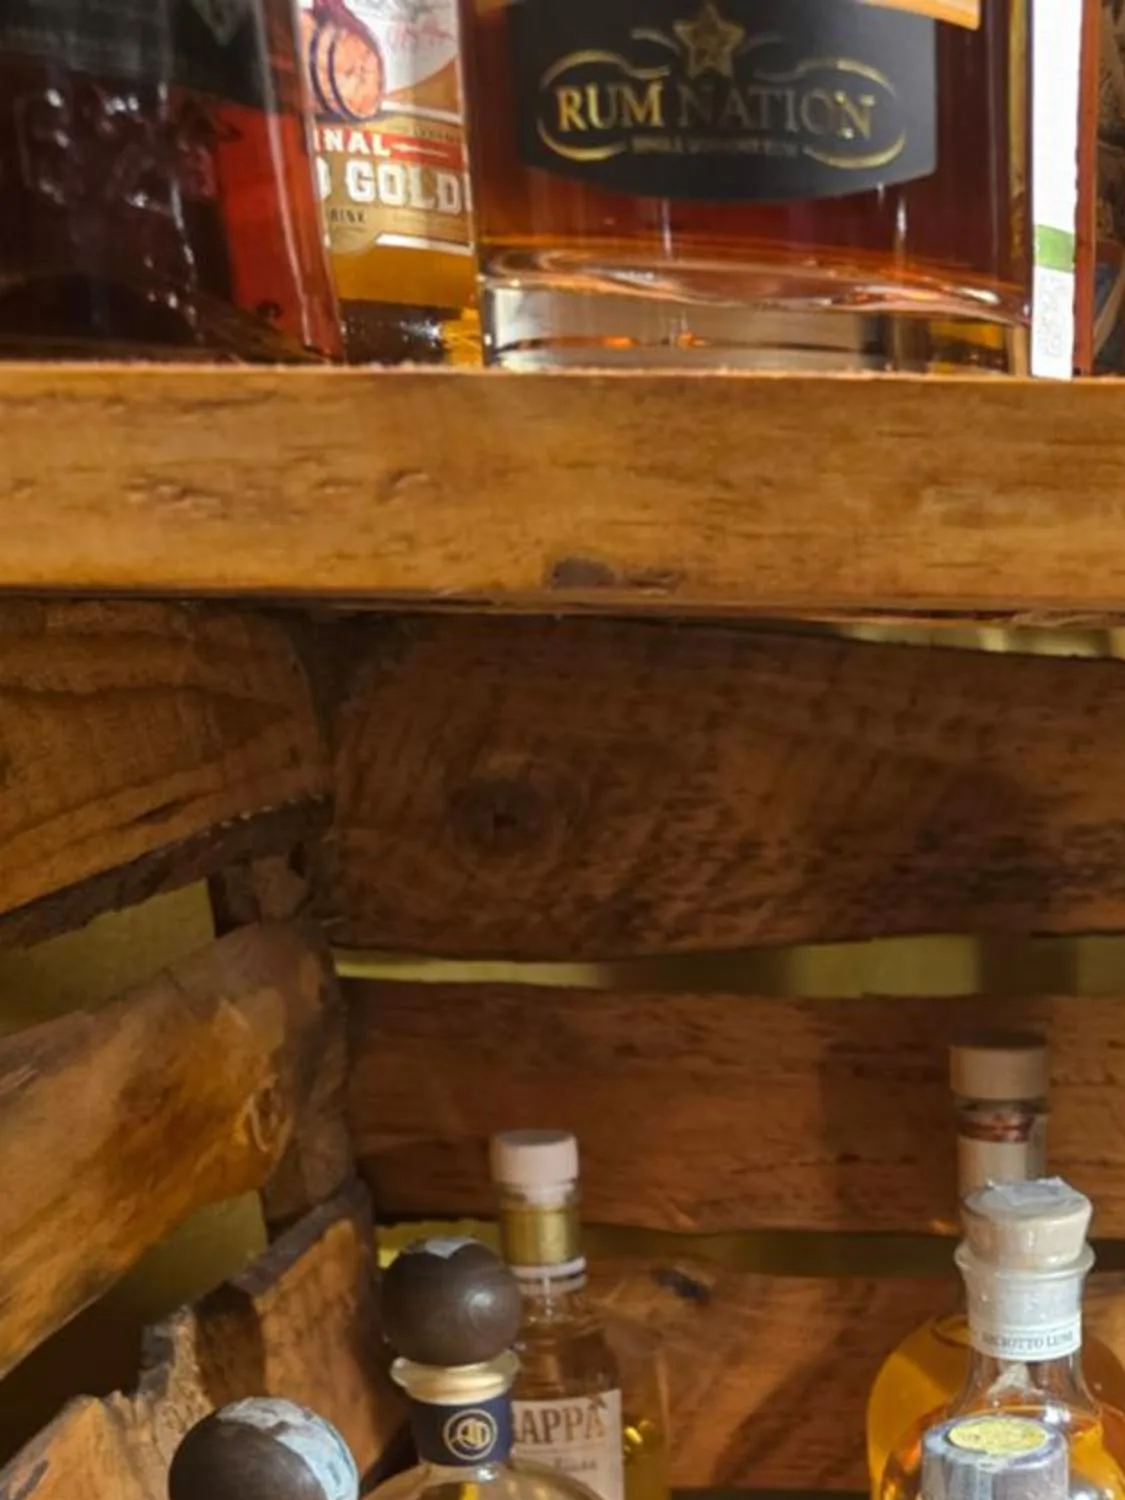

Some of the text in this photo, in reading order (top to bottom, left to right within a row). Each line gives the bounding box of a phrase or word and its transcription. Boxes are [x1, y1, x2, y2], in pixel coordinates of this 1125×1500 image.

[556, 83, 875, 140] RUM NATION
[314, 127, 391, 158] INAL
[345, 158, 462, 215] GOLD
[514, 1401, 609, 1447] APPA
